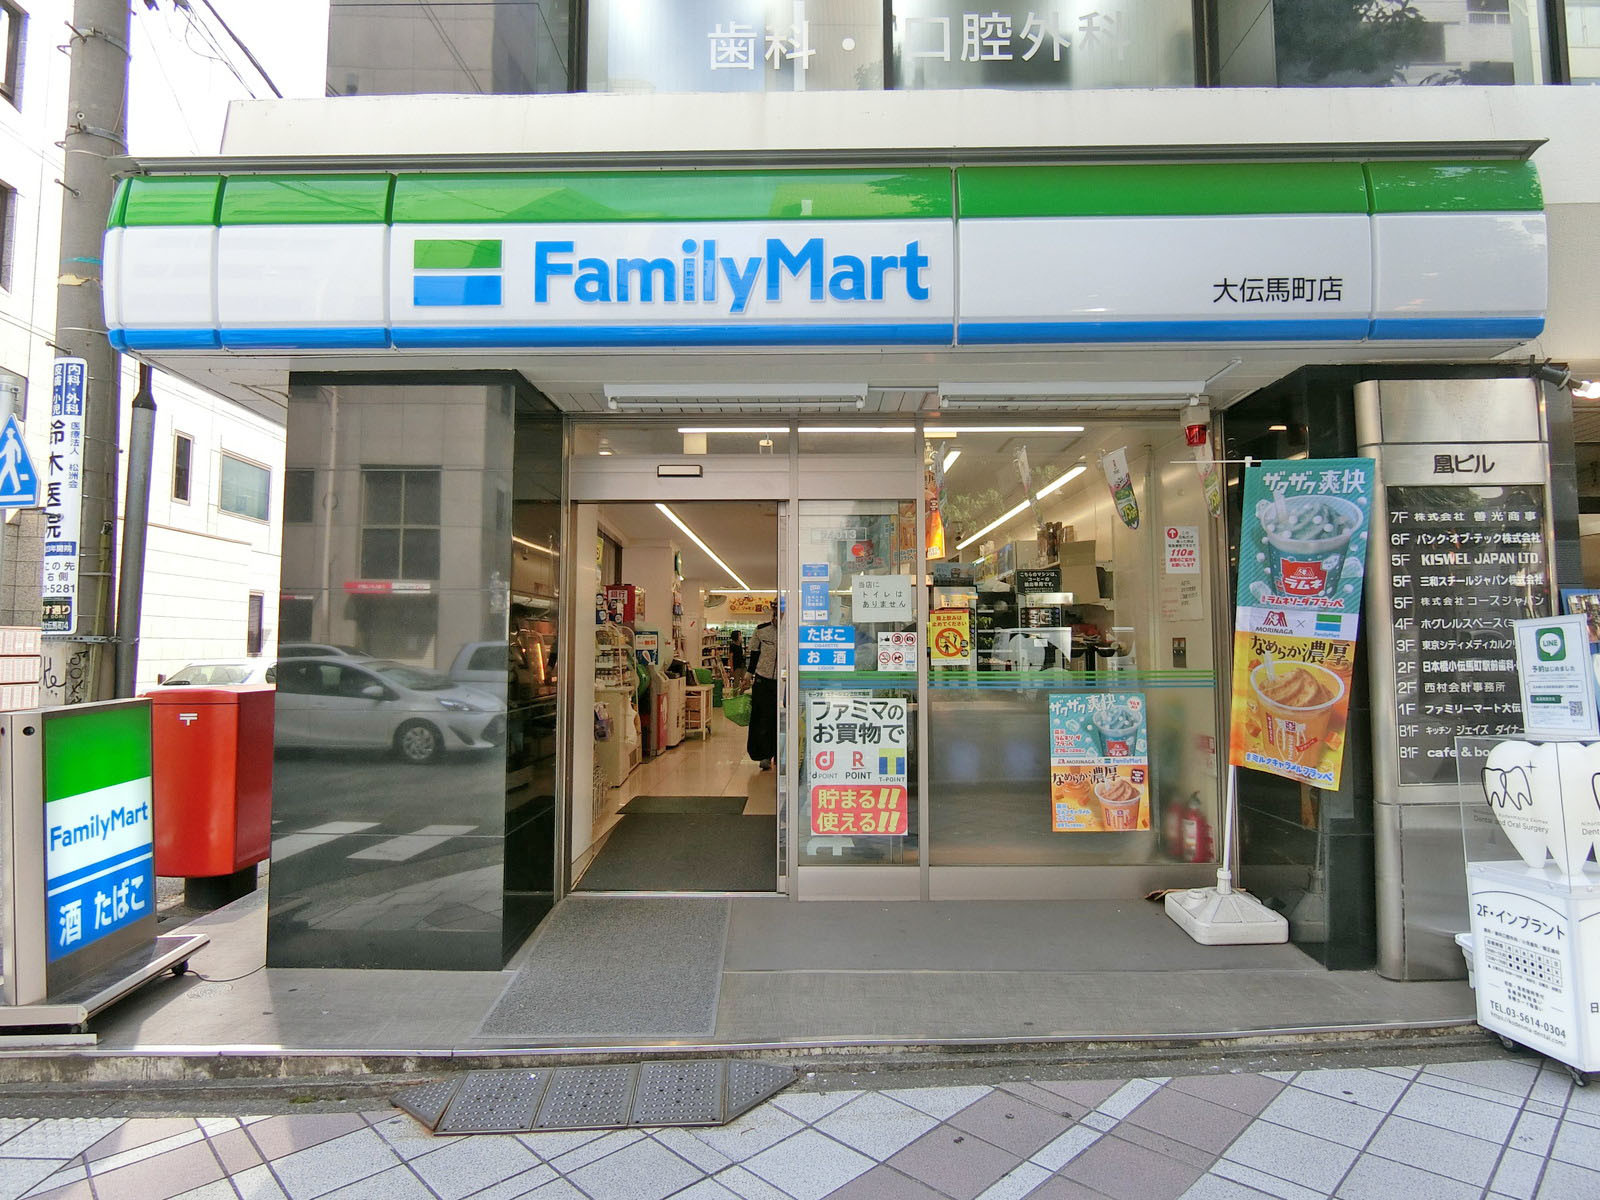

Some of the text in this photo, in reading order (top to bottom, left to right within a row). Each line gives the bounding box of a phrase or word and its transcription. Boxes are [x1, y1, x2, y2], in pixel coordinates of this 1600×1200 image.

[706, 10, 1122, 71] 歯科・口腔外科
[533, 237, 930, 313] FamilyMart
[1213, 276, 1343, 303] 大伝馬町店
[66, 364, 81, 415] 内科・外科
[1262, 468, 1366, 494] ザクザク爽快
[1391, 511, 1408, 523] 7F
[1414, 511, 1465, 522] 株式会社
[1391, 533, 1541, 546] 6F バンク・オブ・テック株式会社
[45, 561, 75, 571] この先
[1391, 552, 1542, 567] 5F KISWEL JAPAN LTD.
[1284, 577, 1323, 590] ラムネ
[1392, 574, 1544, 587] 5F 三和スチールジャパン株式会社
[862, 601, 906, 609] ありません
[1393, 594, 1545, 609] 5F 株式会社 コースジャパン
[1255, 626, 1294, 635] MORINAGA
[1394, 617, 1413, 630] 4F
[807, 628, 846, 641] たばこ
[1250, 635, 1350, 665] なめらか濃厚
[1396, 639, 1415, 652] 3F
[807, 650, 847, 664] お酒
[1397, 659, 1518, 673] 2F 日本橋小伝馬町駅前歯科・
[1398, 682, 1506, 694] 2F 西村会計事務所
[812, 700, 904, 721] ファミマの
[1398, 702, 1523, 715] 1F ファミリーマート大伝
[812, 722, 905, 744] お買物で
[1399, 725, 1419, 737] B1F
[1425, 726, 1452, 735] キッチン
[1456, 724, 1489, 735] ジェイズ
[1400, 746, 1419, 759] B1F
[1427, 746, 1457, 758] cafe
[1461, 747, 1473, 757] &
[845, 771, 872, 780] POINT
[50, 801, 148, 851] FamilyMart
[816, 810, 901, 833] 使える!!
[1507, 820, 1521, 829] Oral
[1523, 822, 1549, 835] Surgery
[59, 874, 145, 947] 酒 たばこ
[1490, 999, 1567, 1039] TEL.03-5614-0304
